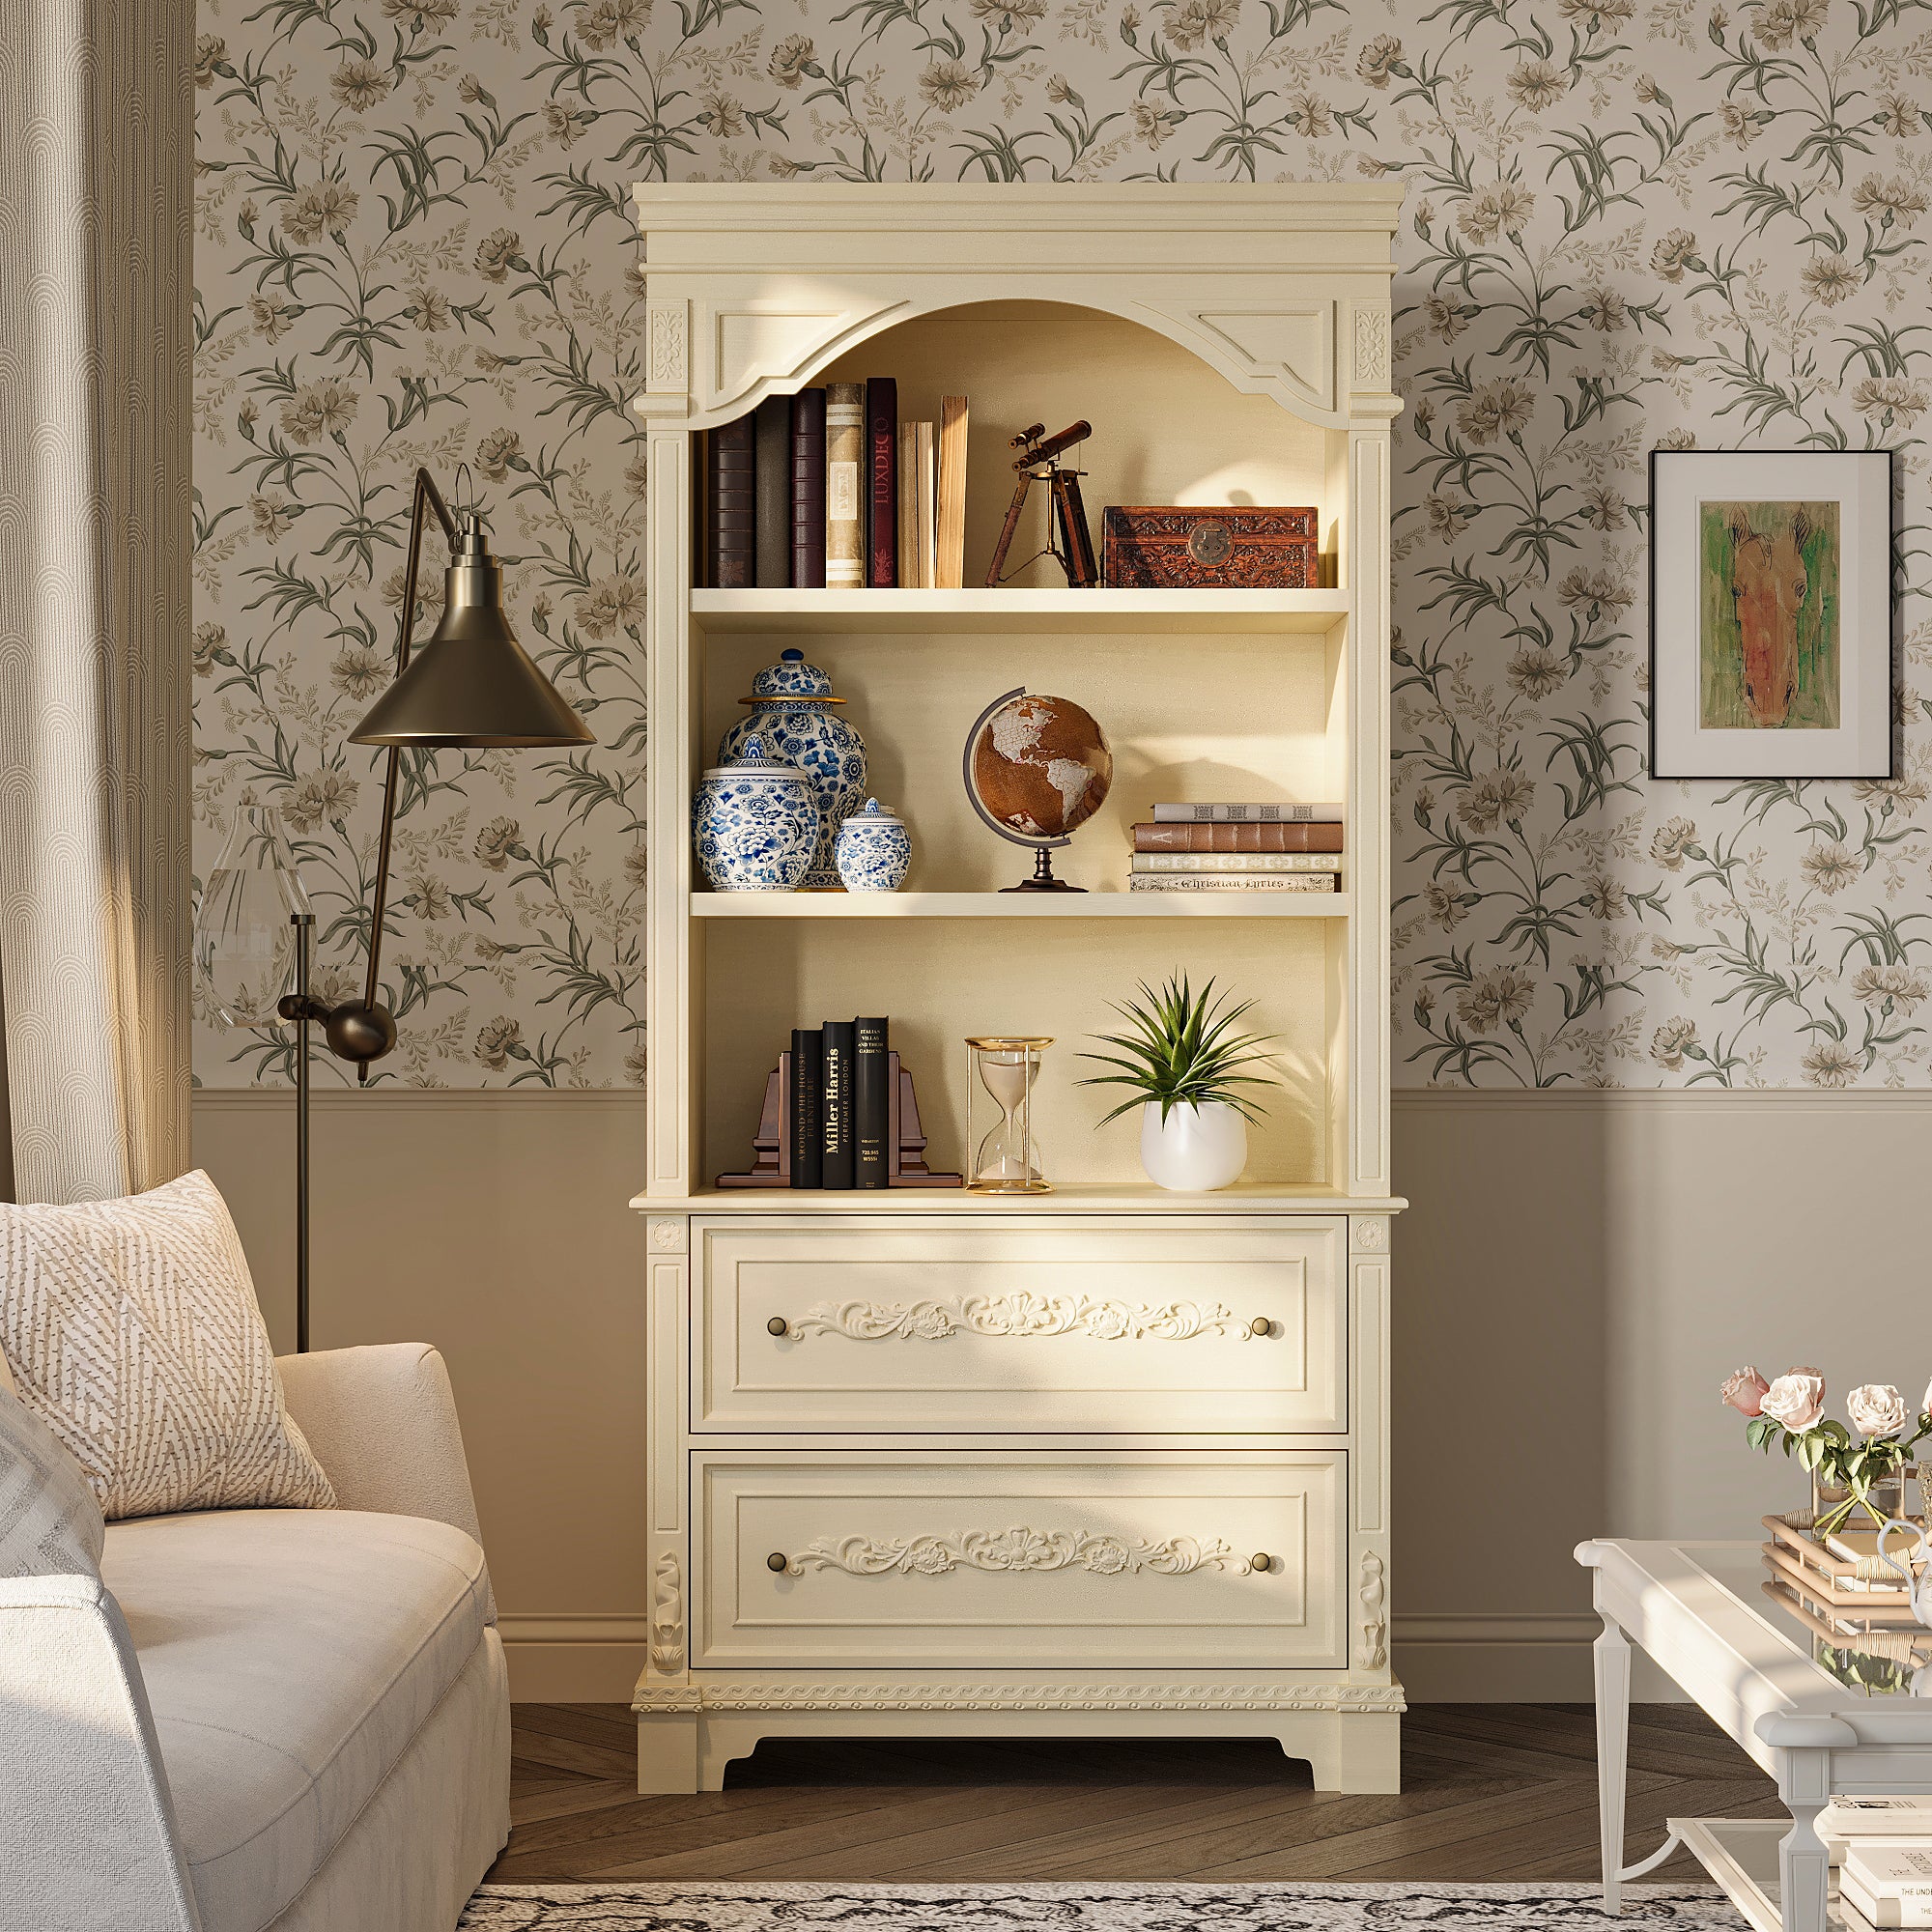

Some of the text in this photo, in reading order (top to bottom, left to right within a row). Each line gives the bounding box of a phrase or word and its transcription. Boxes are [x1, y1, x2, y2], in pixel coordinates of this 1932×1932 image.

[874, 416, 890, 504] LUXDECO
[825, 1048, 839, 1154] Miller Harris
